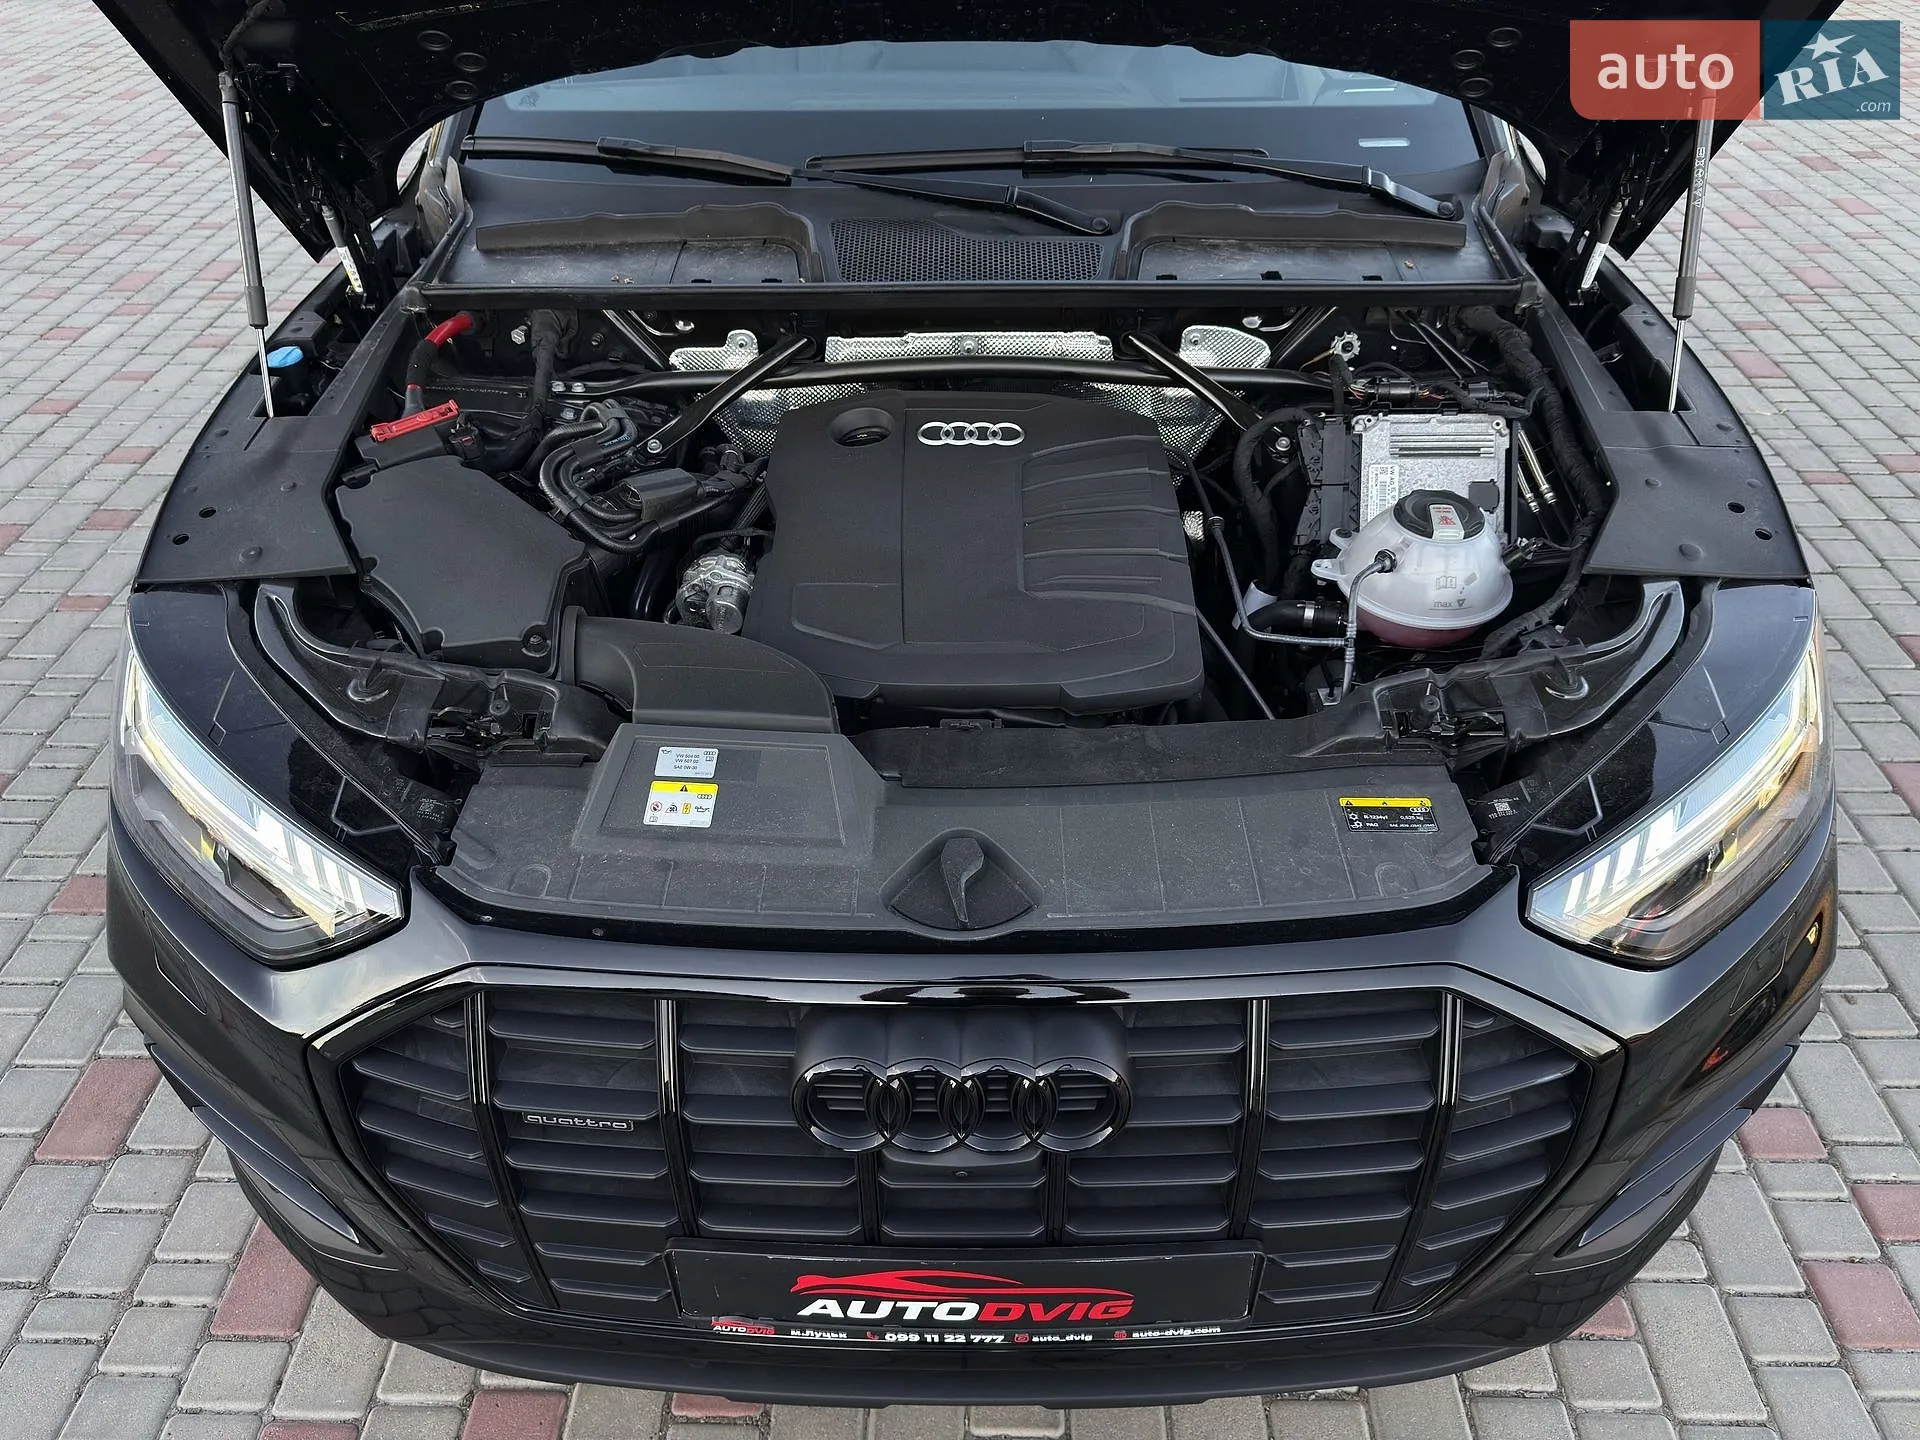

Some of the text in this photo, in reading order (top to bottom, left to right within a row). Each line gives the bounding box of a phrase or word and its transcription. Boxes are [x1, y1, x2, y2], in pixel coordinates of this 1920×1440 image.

[526, 1115, 627, 1129] quattro
[797, 1299, 1135, 1322] AUTODVIG
[884, 1333, 1005, 1344] 099 11 22 777
[1031, 1333, 1093, 1342] auto_dvig
